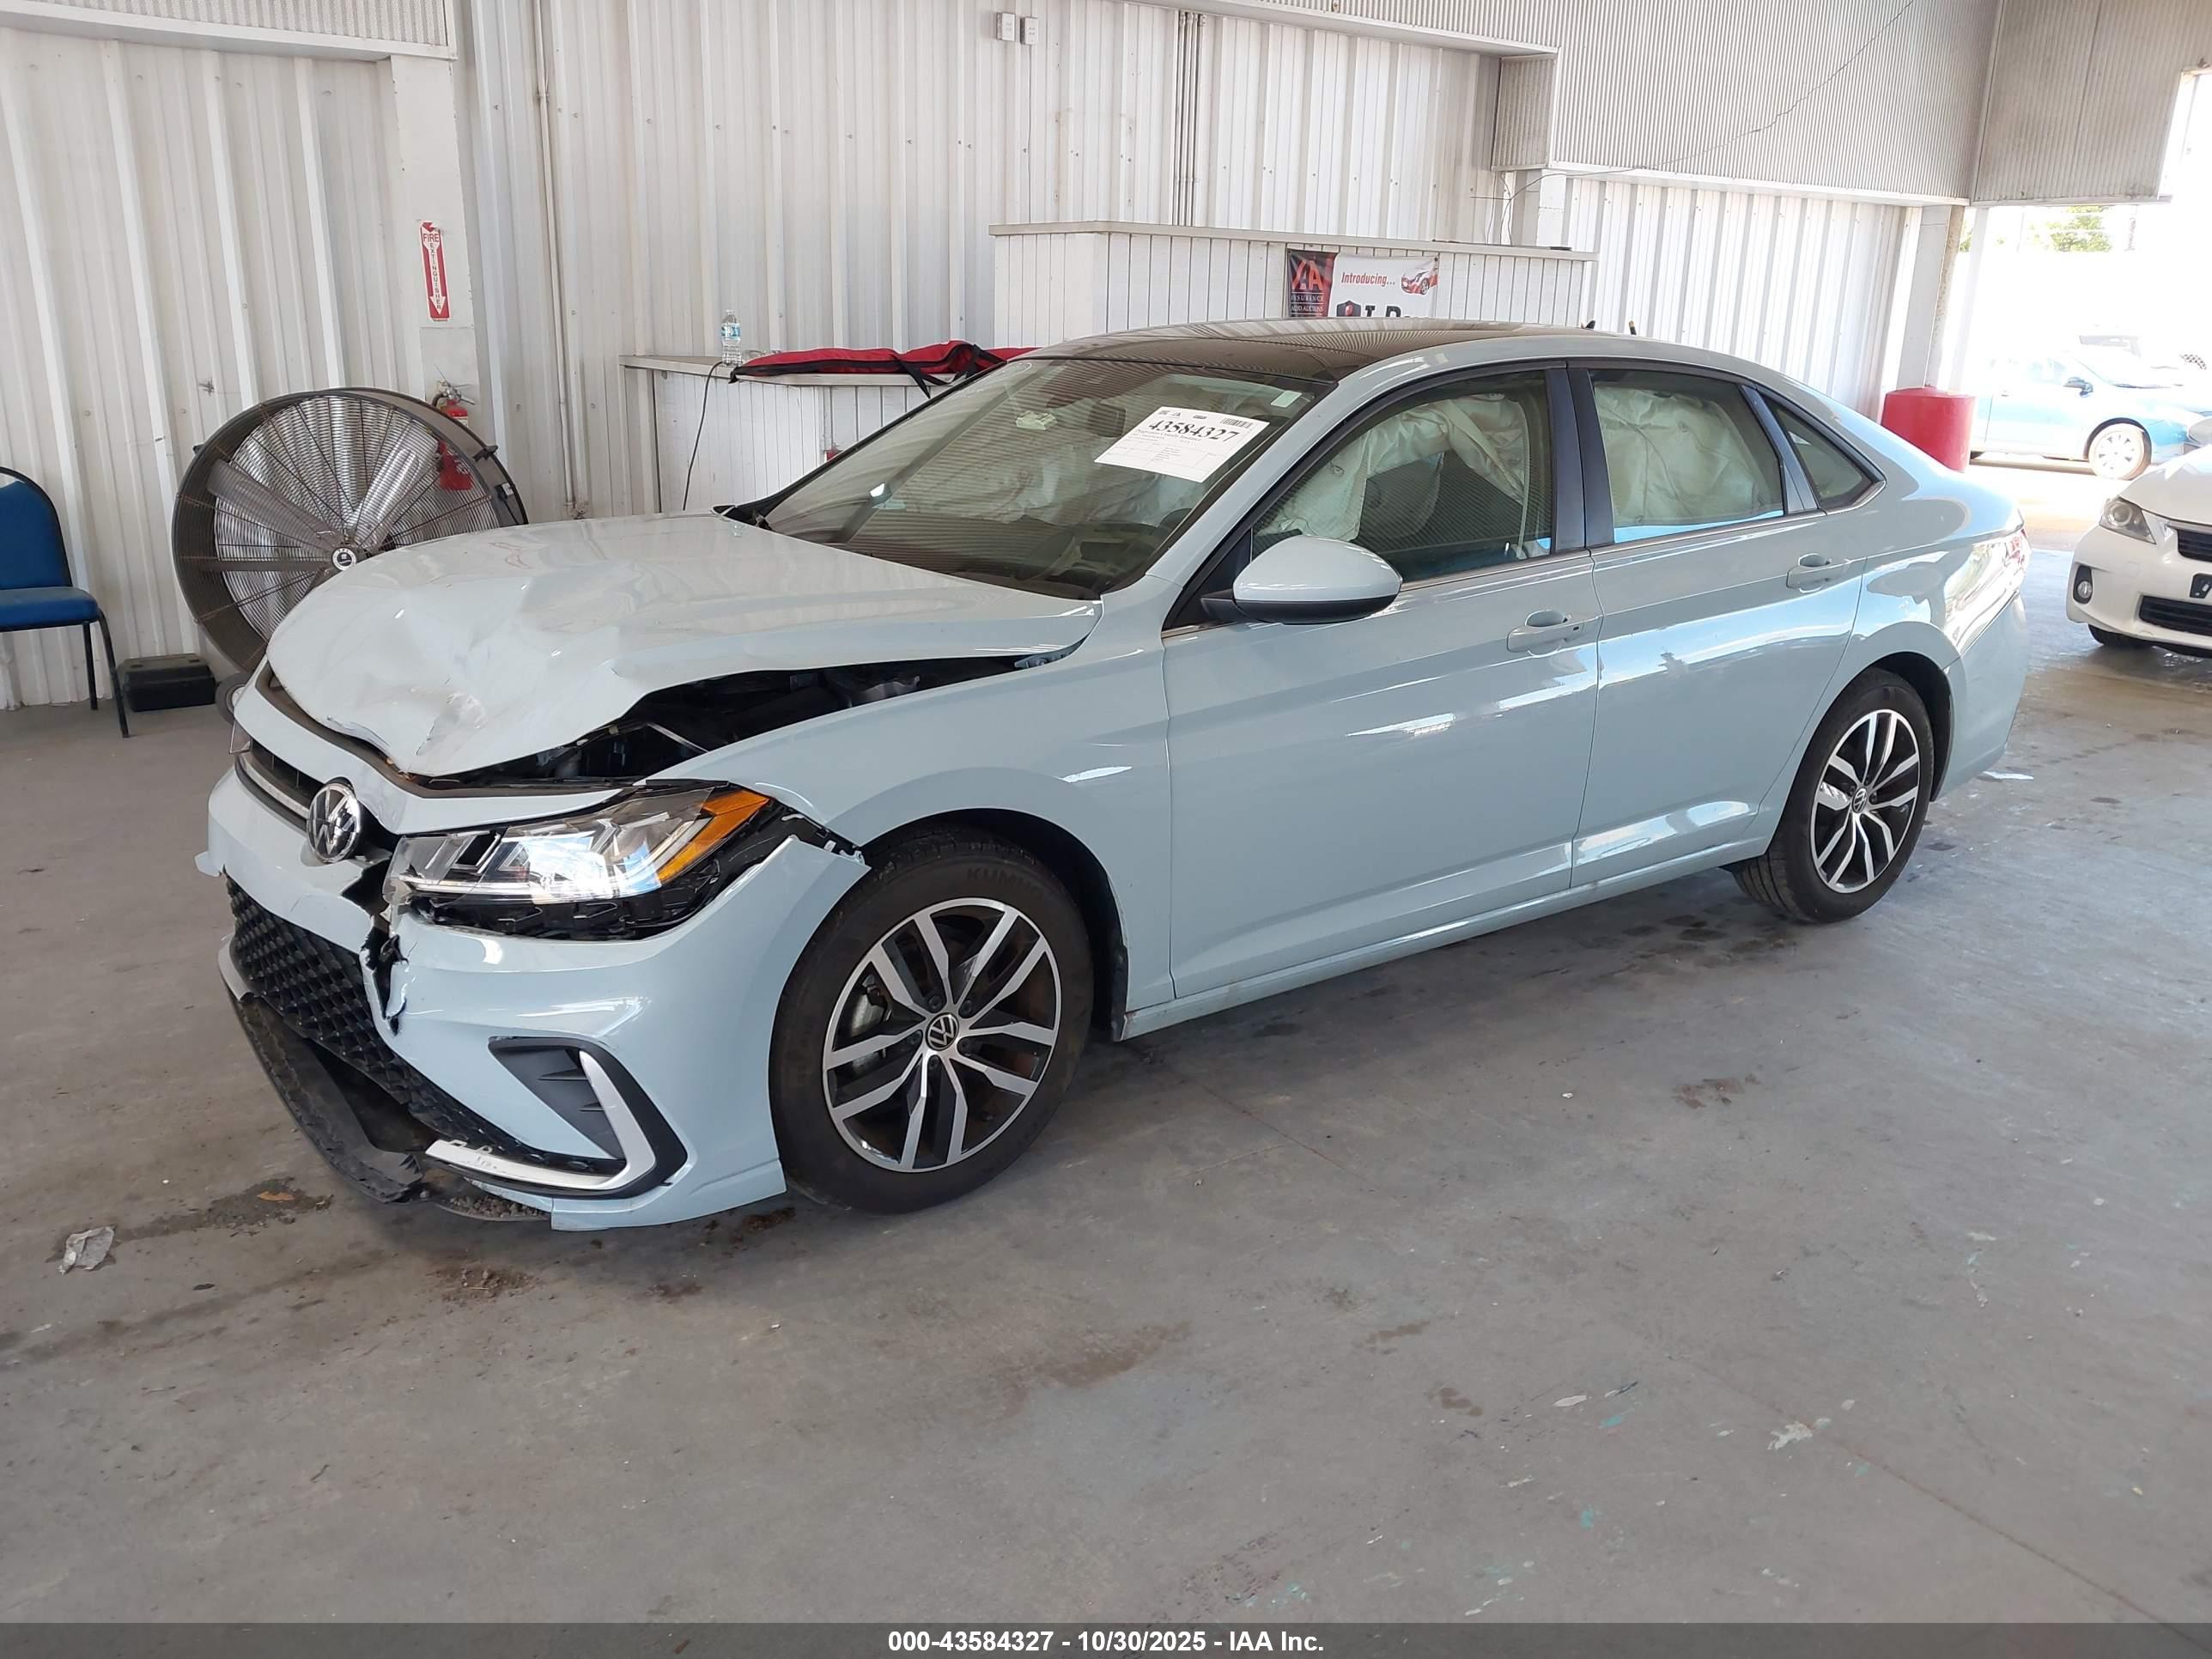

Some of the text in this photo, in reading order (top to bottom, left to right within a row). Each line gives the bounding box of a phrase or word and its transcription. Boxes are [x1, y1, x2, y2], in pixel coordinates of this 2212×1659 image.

[423, 234, 440, 242] FIRE
[430, 243, 441, 310] EXTINGUISHER
[1341, 271, 1395, 288] Introducing...
[1148, 419, 1241, 442] 43584327
